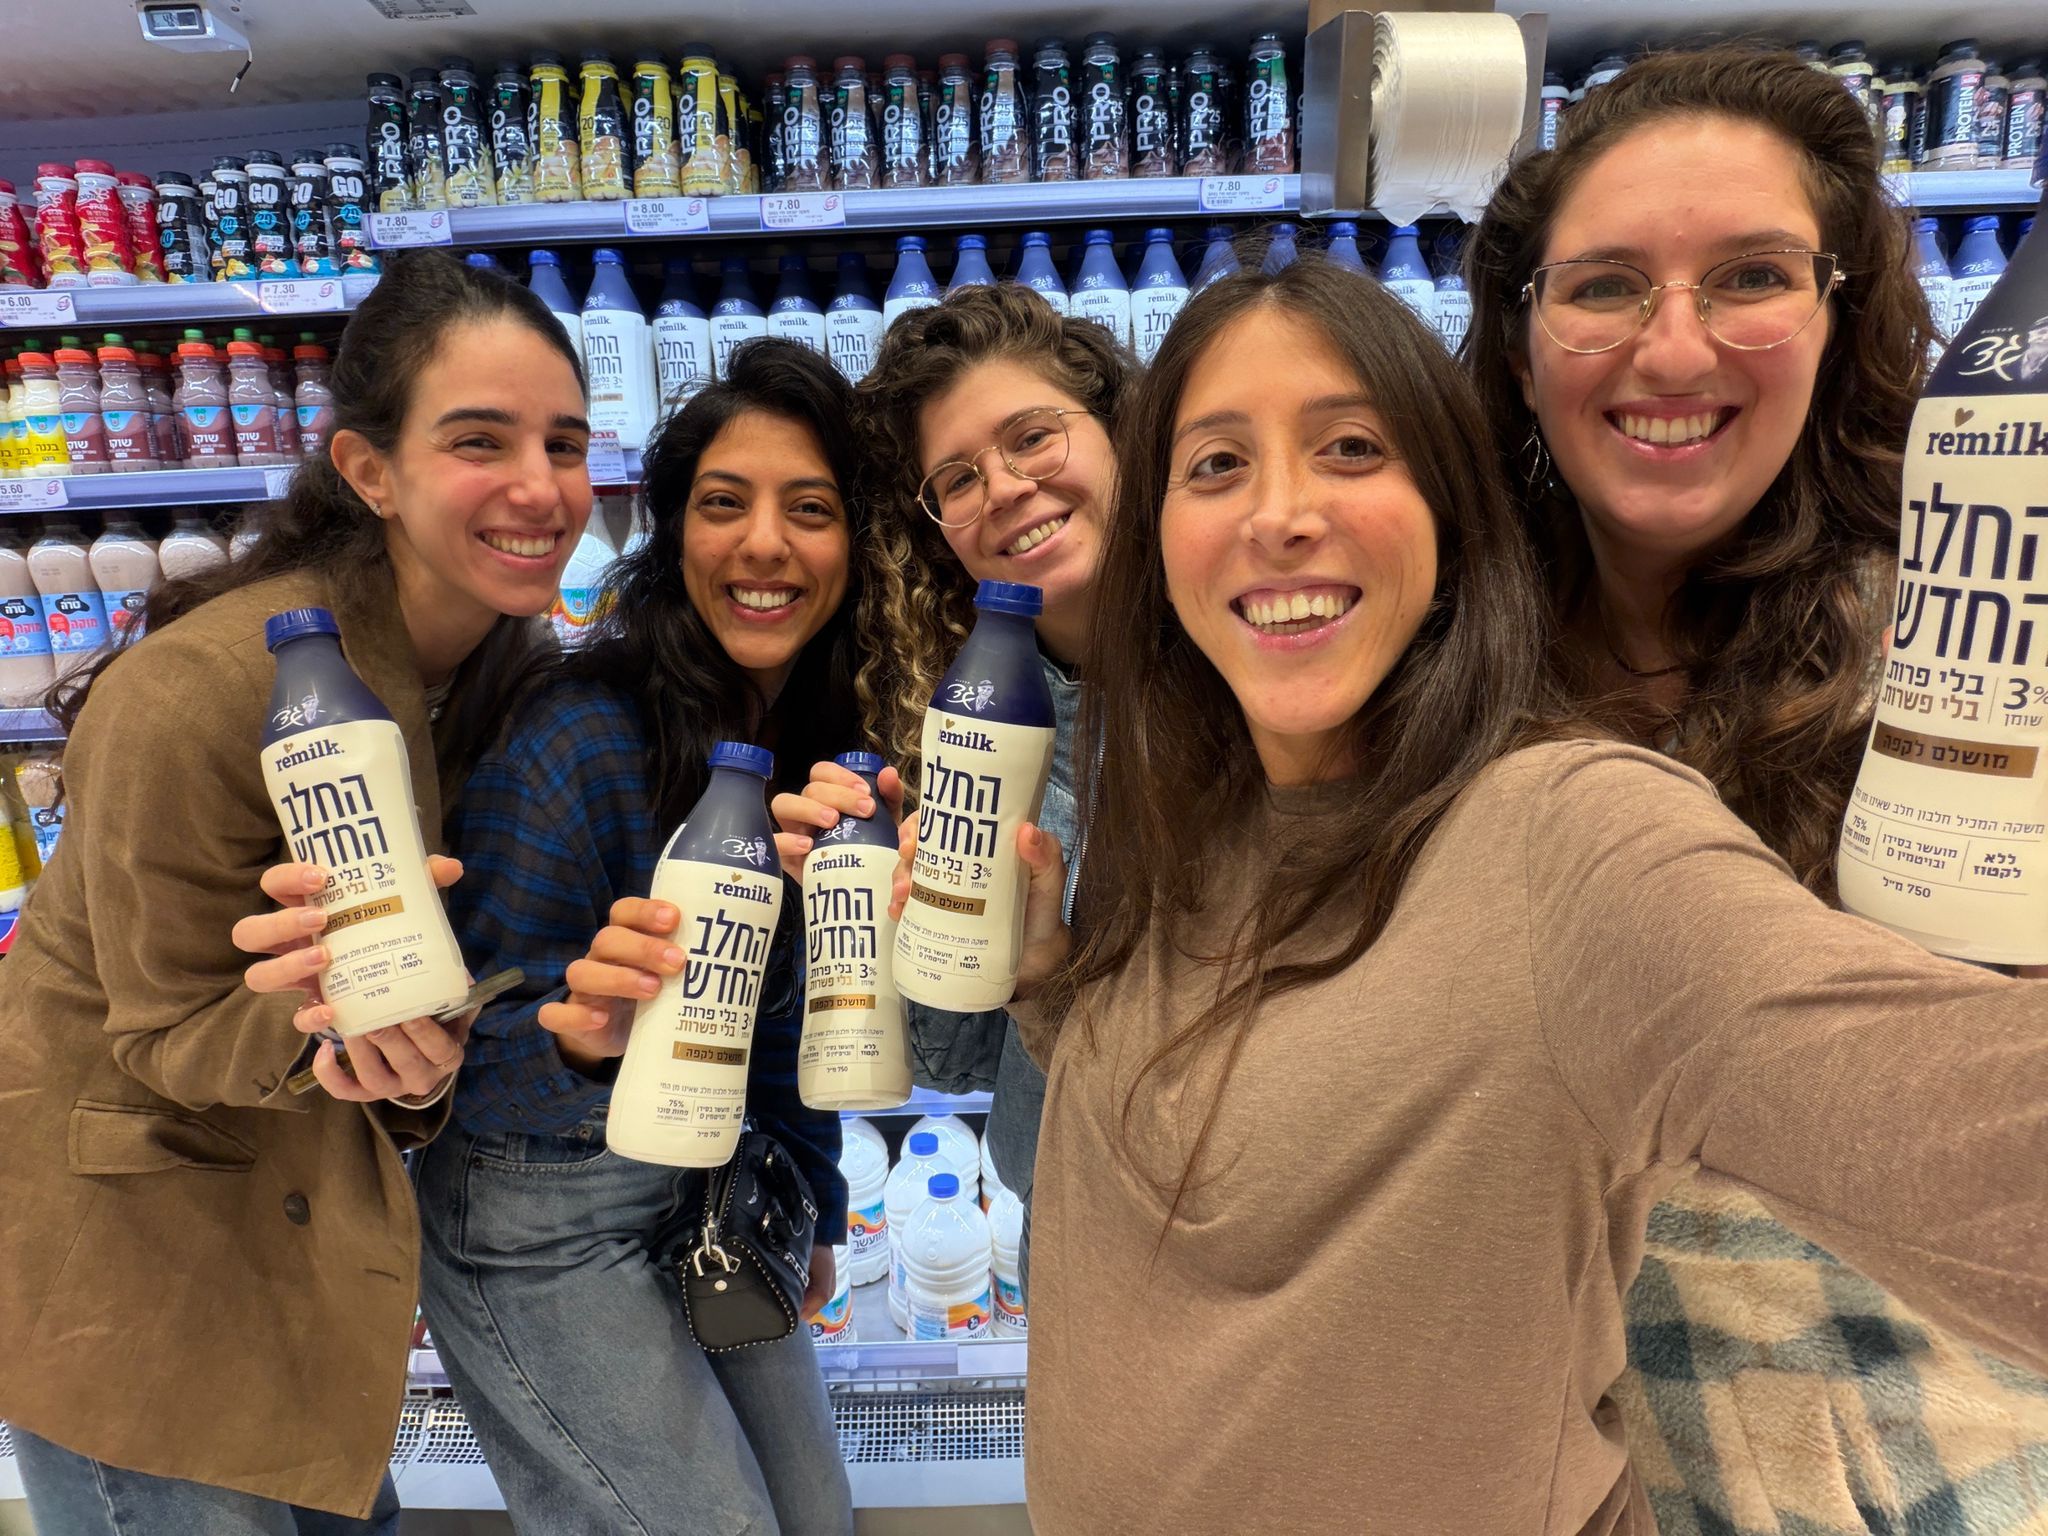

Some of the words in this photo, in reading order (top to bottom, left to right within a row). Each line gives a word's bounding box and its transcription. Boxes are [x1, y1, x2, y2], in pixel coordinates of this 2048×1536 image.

[1053, 86, 1071, 144] PRO
[1092, 83, 1111, 140] PRO
[1250, 79, 1267, 139] PRO
[1955, 85, 1975, 142] PROTEIN
[634, 98, 653, 156] PRO
[679, 94, 696, 154] PRO
[980, 92, 993, 152] PRO
[1136, 95, 1154, 152] PRO
[1190, 92, 1208, 148] PRO
[444, 106, 466, 164] PRO
[492, 110, 509, 169] PRO
[784, 106, 800, 164] PRO
[831, 108, 845, 165] PRO
[884, 105, 900, 162] PRO
[937, 104, 951, 161] PRO
[1543, 111, 1557, 151] OTEIN
[2007, 104, 2026, 158] PROTEIN
[381, 122, 405, 179] PRO
[248, 182, 279, 204] GO
[331, 175, 364, 198] GO
[1217, 181, 1240, 191] 7.80
[214, 188, 238, 210] GO
[641, 203, 664, 213] 8.00
[776, 199, 800, 210] 7.80
[385, 216, 408, 226] 7.80
[272, 283, 295, 294] 7.30
[1960, 280, 1994, 292] remil
[8, 296, 31, 307] 6.00
[658, 337, 695, 360] החלב
[832, 330, 867, 354] החלב
[660, 361, 697, 380] החדש
[35, 442, 59, 452] בננה
[193, 433, 219, 444] שוקו
[0, 484, 23, 495] 5.60
[5, 605, 26, 615] טרה
[60, 600, 81, 610] טרה
[1940, 668, 1985, 695] בלי
[1941, 694, 1979, 722] בלי
[2004, 713, 2043, 727] שומן
[275, 738, 345, 772] remilk.
[1882, 734, 1925, 757] לקפה
[1931, 745, 2010, 770] מושלם
[923, 755, 1002, 815] החלב
[281, 774, 374, 836] החלב
[1892, 803, 1915, 818] חלב
[1917, 809, 1952, 826] חלבון
[1957, 814, 1998, 831] המכיל
[918, 804, 998, 859] החדש
[2002, 822, 2045, 835] משקה
[294, 815, 389, 868] החדש
[1882, 833, 1912, 850] בסידן
[1916, 842, 1958, 859] מועשר
[812, 854, 865, 873] remilk.
[942, 856, 963, 872] בלי
[1897, 849, 1946, 870] ובויטמין
[1984, 852, 2017, 865] ללא
[338, 867, 364, 881] בלי
[371, 862, 396, 881] 3%
[943, 871, 961, 886] בלי
[970, 863, 992, 880] 3%
[1973, 865, 2022, 879] לקטוז
[345, 881, 369, 894] בלי
[713, 881, 773, 905] remilk.
[914, 887, 936, 903] לקפה
[1907, 883, 1932, 899] 750
[808, 882, 874, 927] החלב
[939, 897, 974, 912] מושלם
[689, 908, 770, 966] החלב
[809, 925, 877, 964] החדש
[834, 962, 853, 974] בלי
[859, 963, 878, 979] 3%
[682, 959, 761, 1008] החדש
[836, 974, 853, 986] בלי
[837, 998, 866, 1007] מושלם
[677, 1005, 716, 1021] פרות.
[720, 1008, 738, 1023] בלי
[675, 1019, 718, 1035] פשרות.
[720, 1023, 736, 1037] בלי
[685, 1047, 714, 1060] לקפה
[668, 1099, 685, 1108] 75%
[852, 1229, 885, 1249] מועשר
